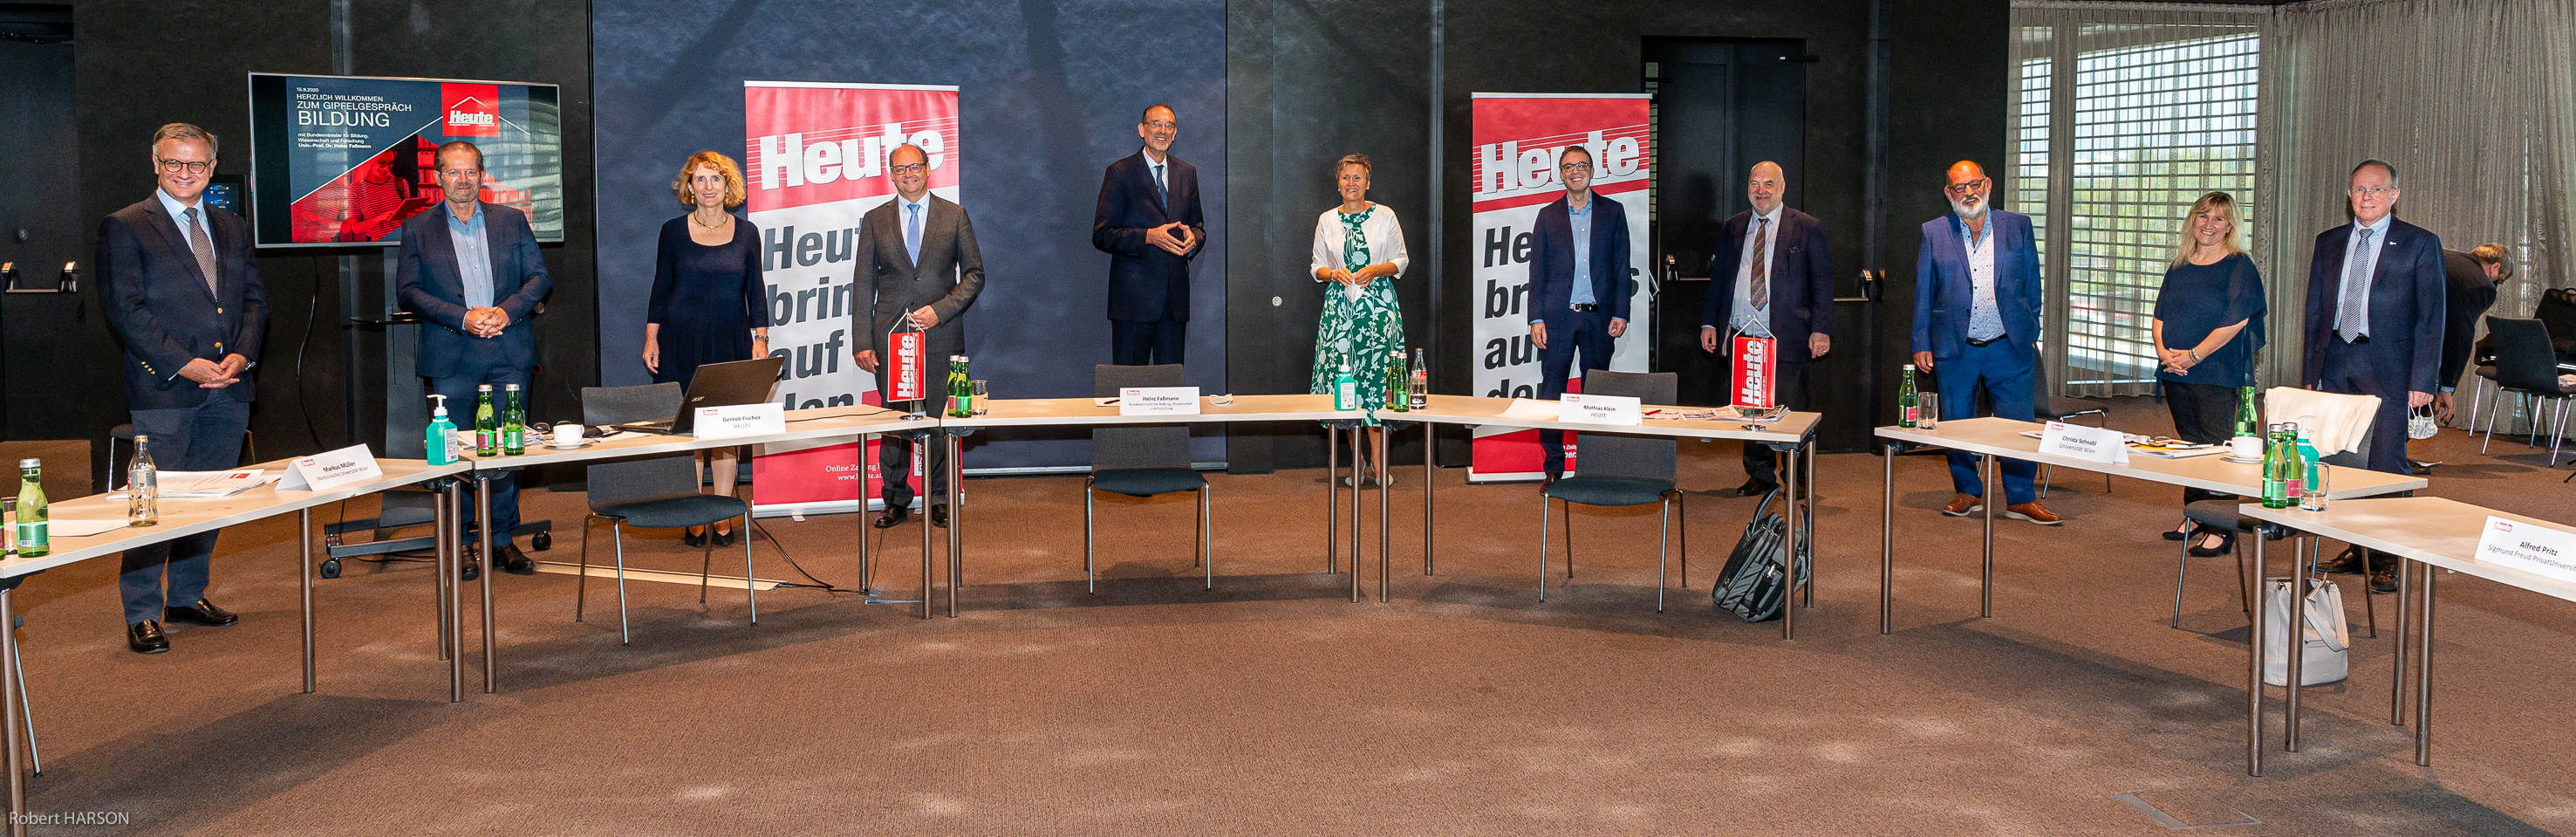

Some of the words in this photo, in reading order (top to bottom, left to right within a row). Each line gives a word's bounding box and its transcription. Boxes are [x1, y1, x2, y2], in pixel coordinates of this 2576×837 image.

[323, 101, 412, 112] GIPFELGESPRÄCH
[298, 111, 390, 127] BILDUNG
[449, 110, 494, 124] Heute
[760, 123, 945, 190] Heute
[763, 218, 864, 272] Heu
[897, 335, 915, 397] Heute
[1741, 340, 1763, 406] Heute
[2059, 443, 2083, 452] Universität
[2488, 544, 2514, 556] Sigmund
[2514, 551, 2532, 560] Freud
[2519, 541, 2542, 552] Alfred
[2542, 546, 2559, 556] Pritz
